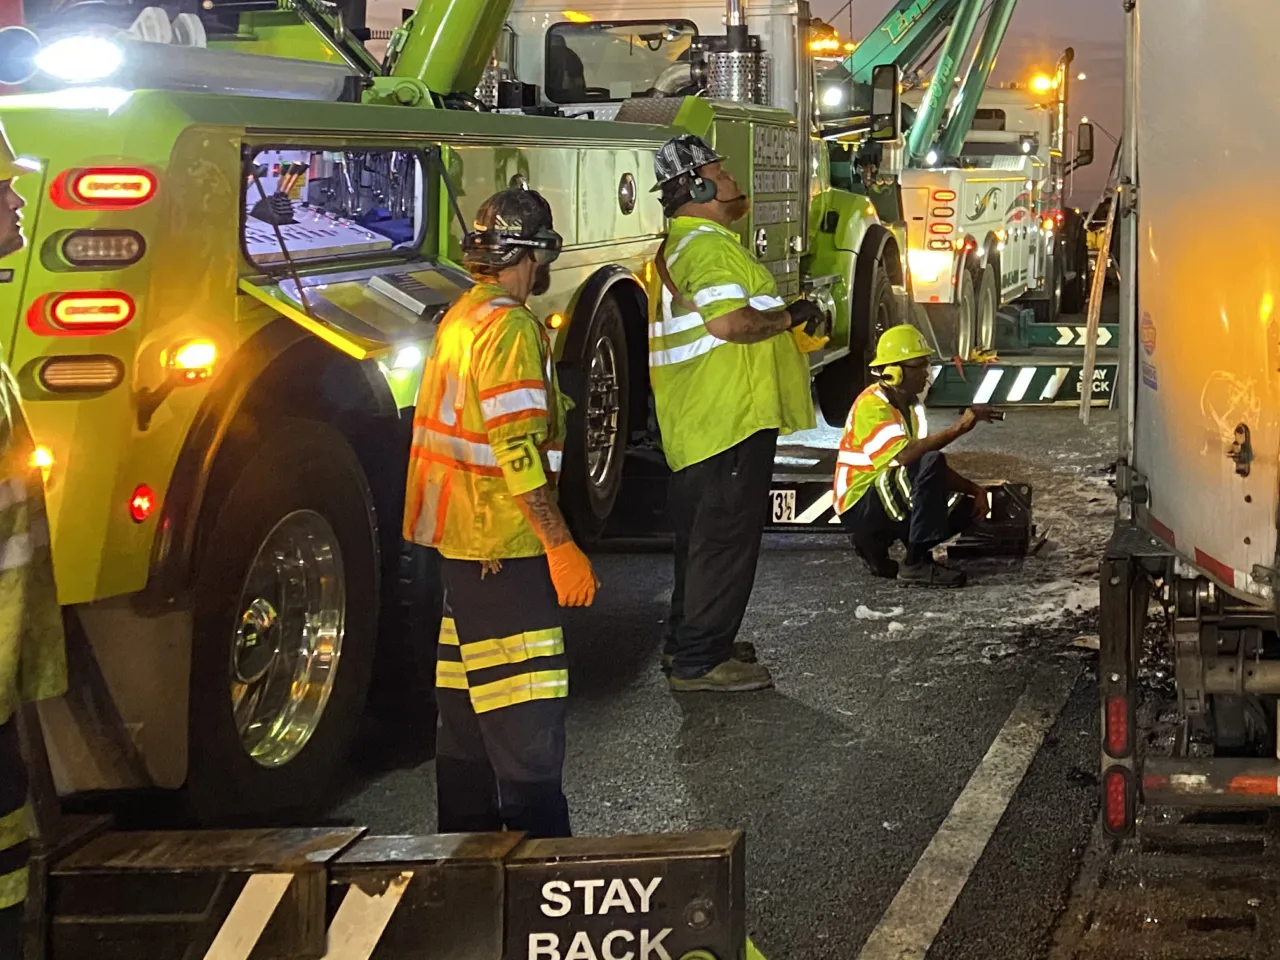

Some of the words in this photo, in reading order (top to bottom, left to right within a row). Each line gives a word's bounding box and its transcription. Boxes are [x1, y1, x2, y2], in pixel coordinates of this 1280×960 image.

[1078, 368, 1108, 381] SAY
[1076, 381, 1110, 393] BCK
[539, 876, 663, 918] STAY
[528, 927, 673, 960] BACK
